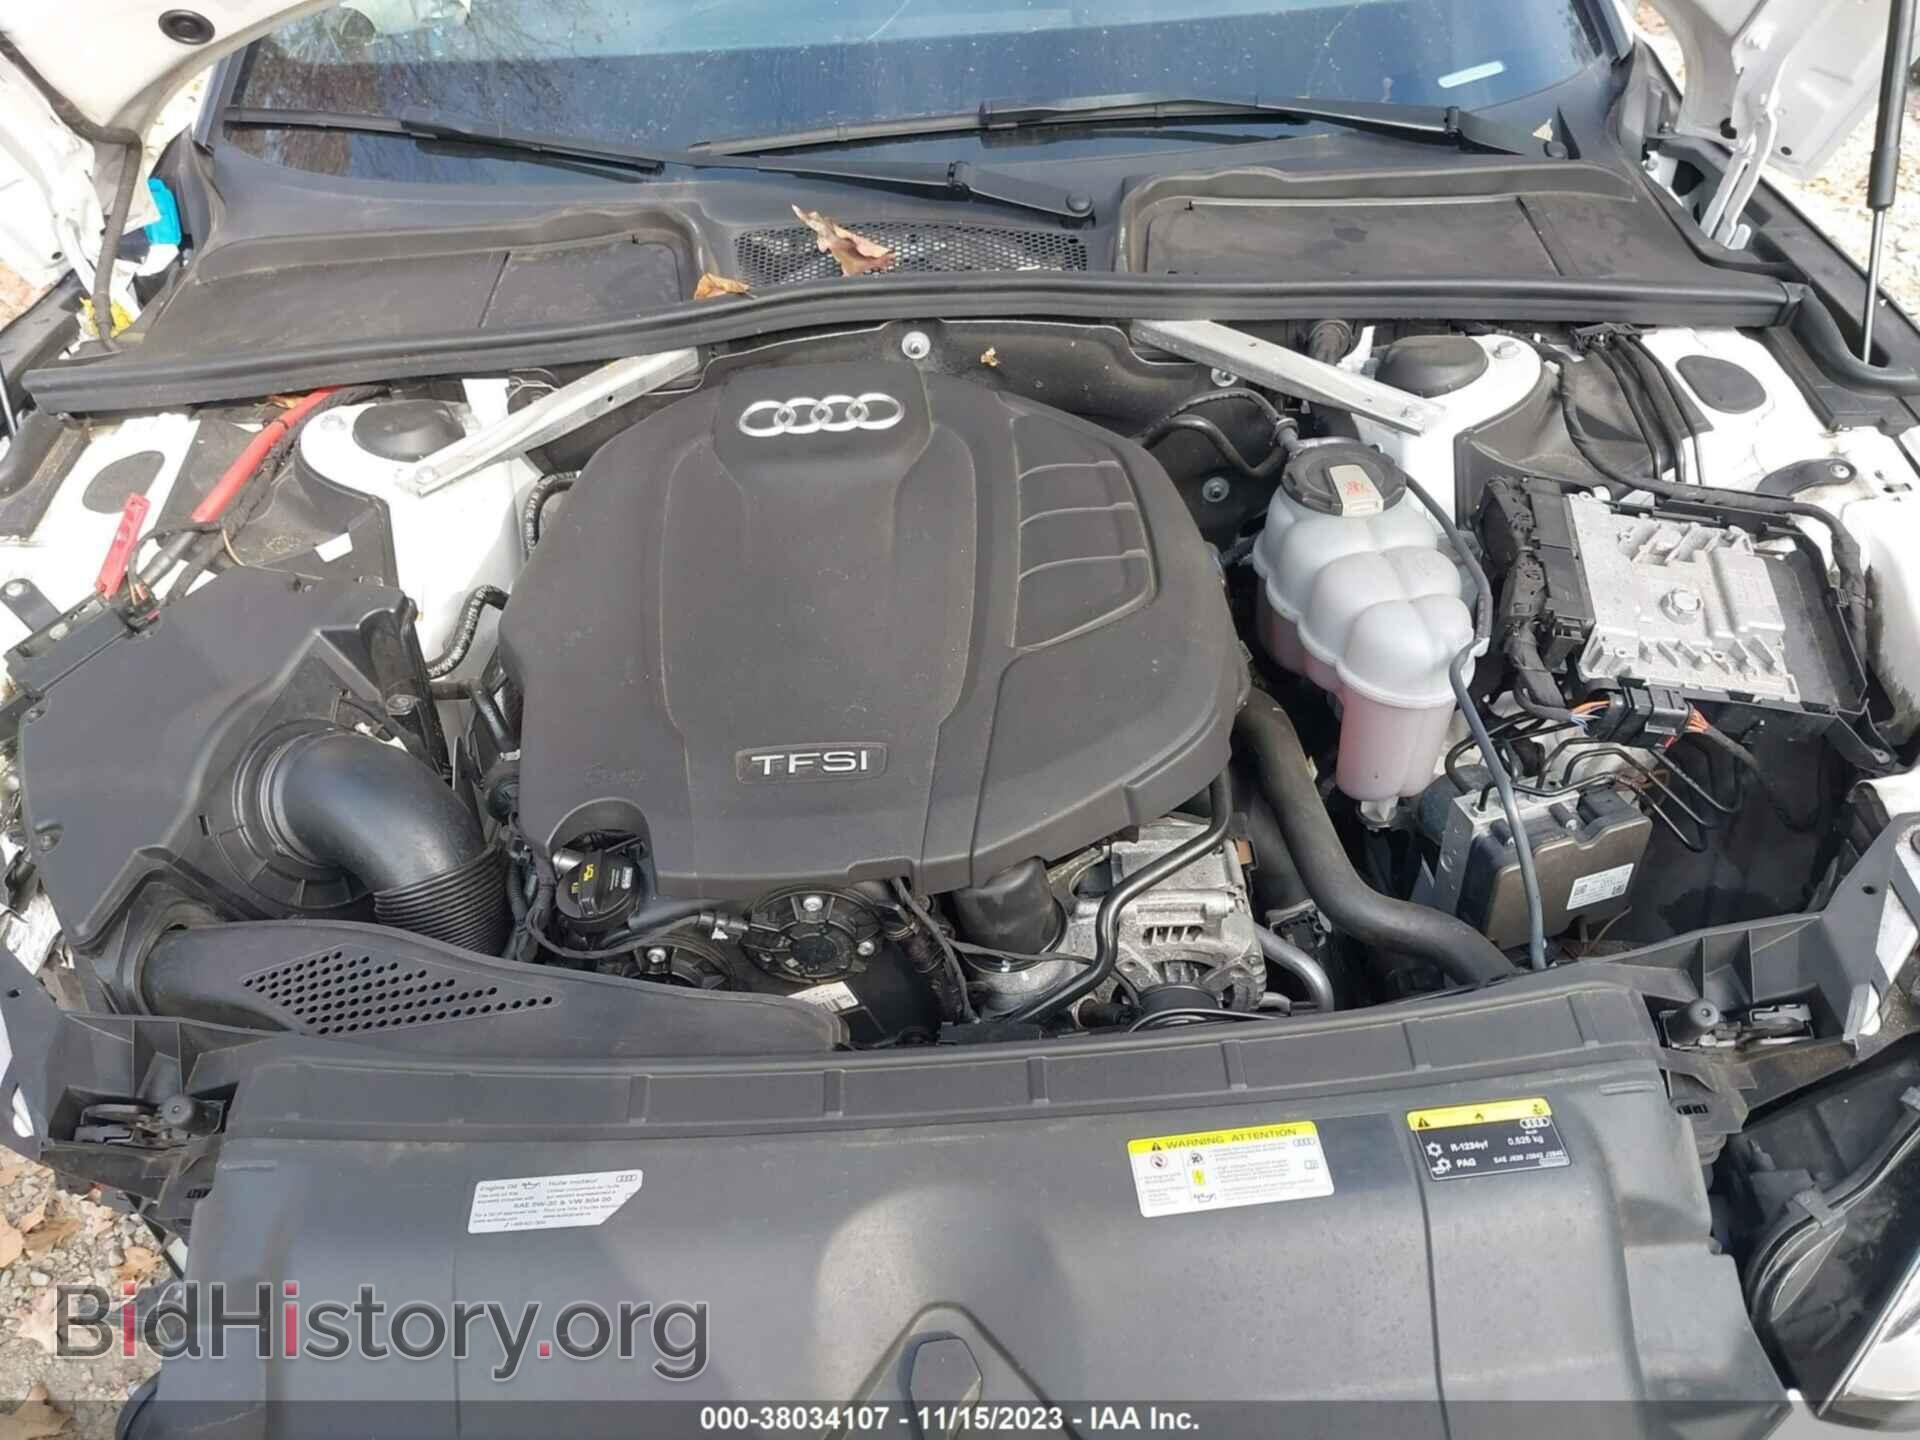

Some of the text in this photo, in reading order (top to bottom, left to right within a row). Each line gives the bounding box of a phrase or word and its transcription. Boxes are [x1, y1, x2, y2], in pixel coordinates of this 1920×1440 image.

[751, 750, 868, 776] TFSI
[1165, 1127, 1298, 1150] WARNING ATTENTION
[1456, 1158, 1477, 1168] PAG
